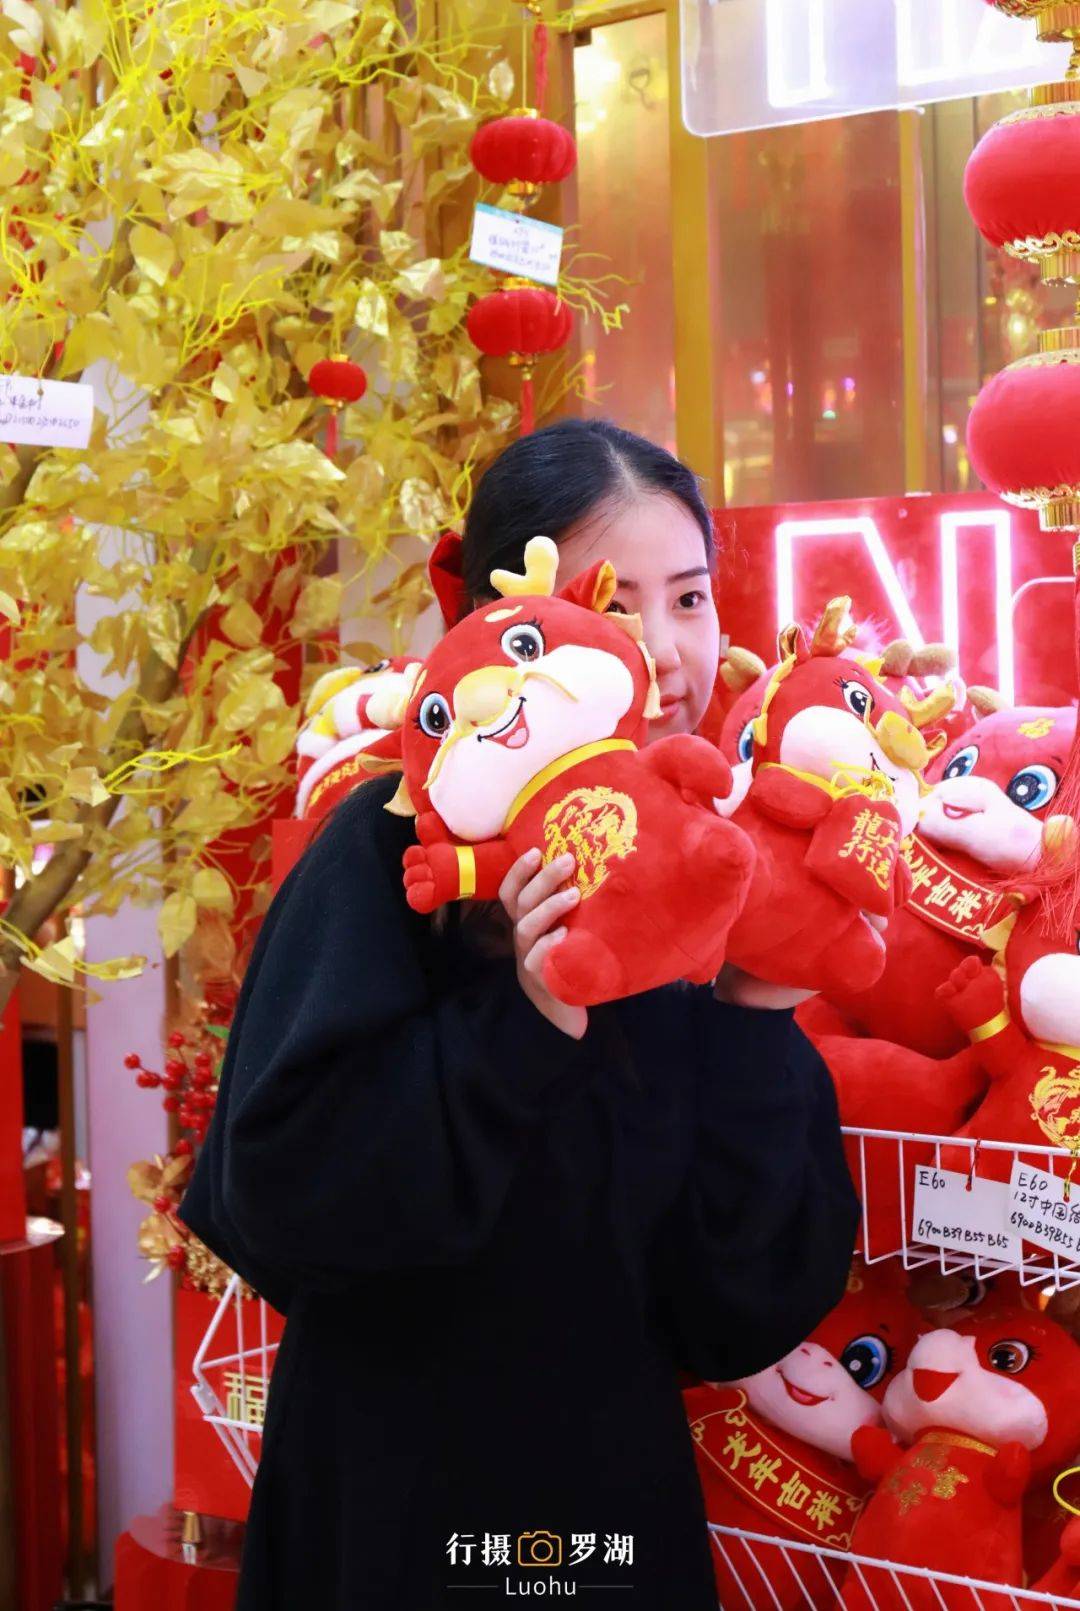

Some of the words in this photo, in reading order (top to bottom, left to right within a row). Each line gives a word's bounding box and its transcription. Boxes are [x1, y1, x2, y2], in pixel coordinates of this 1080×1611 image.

[919, 1171, 946, 1190] E60
[1018, 1172, 1048, 1191] E60
[722, 1430, 842, 1531] 龙年吉祥
